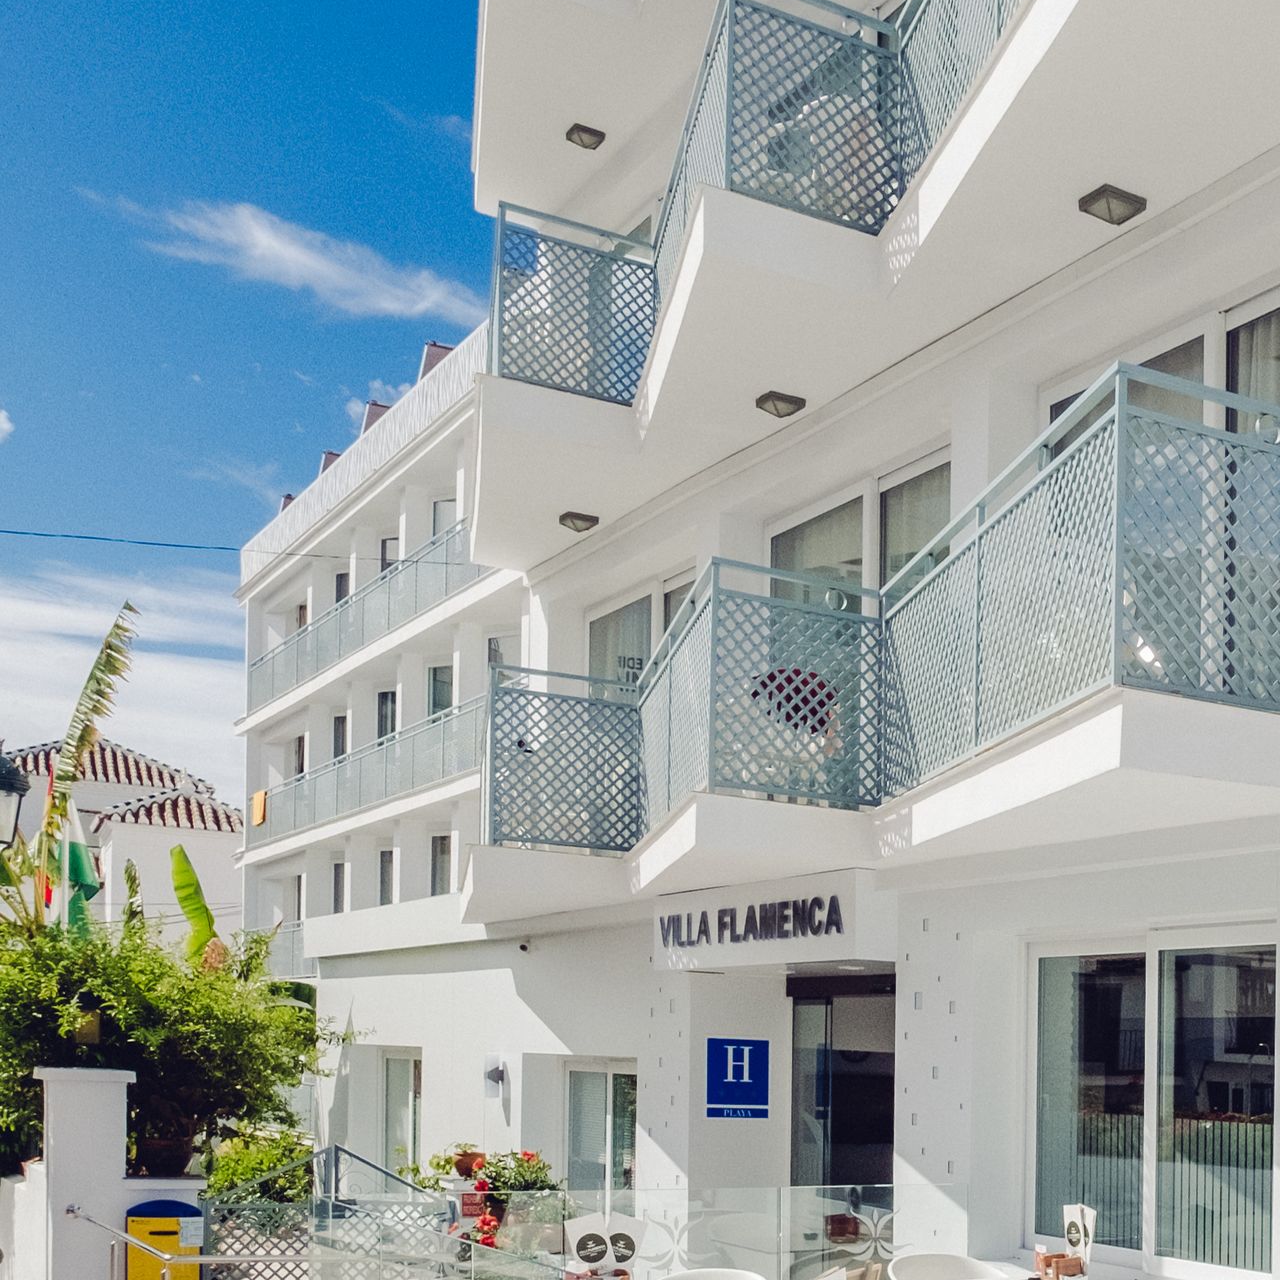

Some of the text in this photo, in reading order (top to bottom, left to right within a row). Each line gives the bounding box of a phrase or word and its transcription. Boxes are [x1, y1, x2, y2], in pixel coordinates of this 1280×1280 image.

[660, 895, 845, 948] VILLA FLAMENCA
[723, 1045, 753, 1082] H
[723, 1108, 752, 1117] PLAYA
